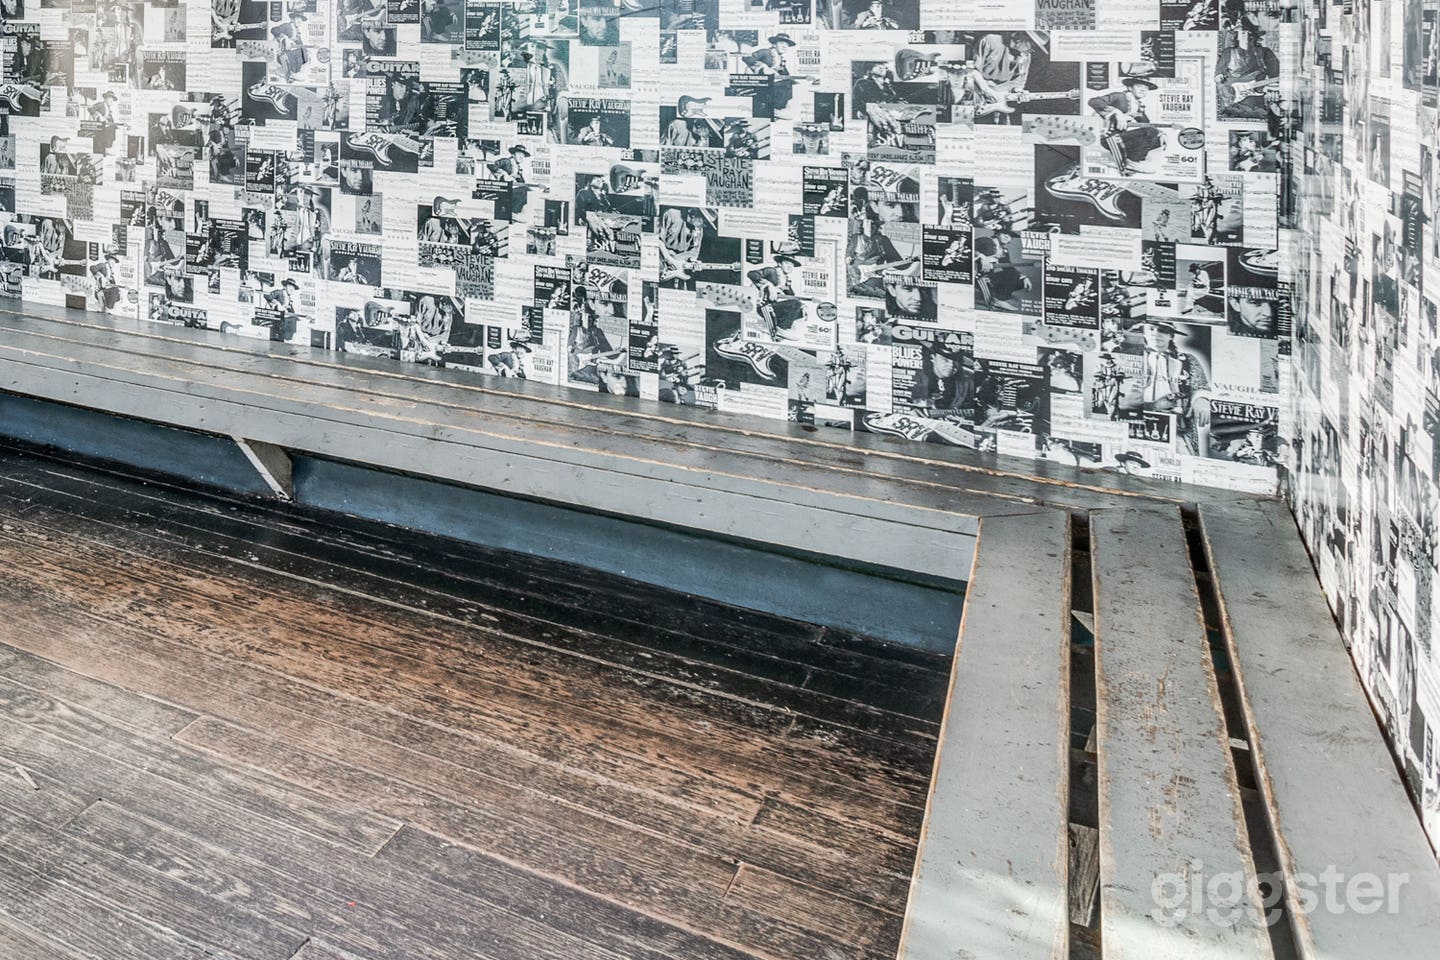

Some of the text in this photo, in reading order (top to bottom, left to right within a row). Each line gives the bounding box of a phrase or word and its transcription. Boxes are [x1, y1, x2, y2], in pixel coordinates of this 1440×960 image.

[366, 61, 420, 74] GUITAR
[1159, 94, 1180, 103] STEVIE
[1162, 102, 1191, 112] VAUGHAN
[876, 132, 904, 148] SRV
[707, 153, 748, 170] STEVIE
[722, 168, 744, 180] RAY
[706, 173, 750, 190] VAUGHAN
[892, 346, 923, 360] BLUES
[1210, 401, 1265, 419] STEVIE RAY
